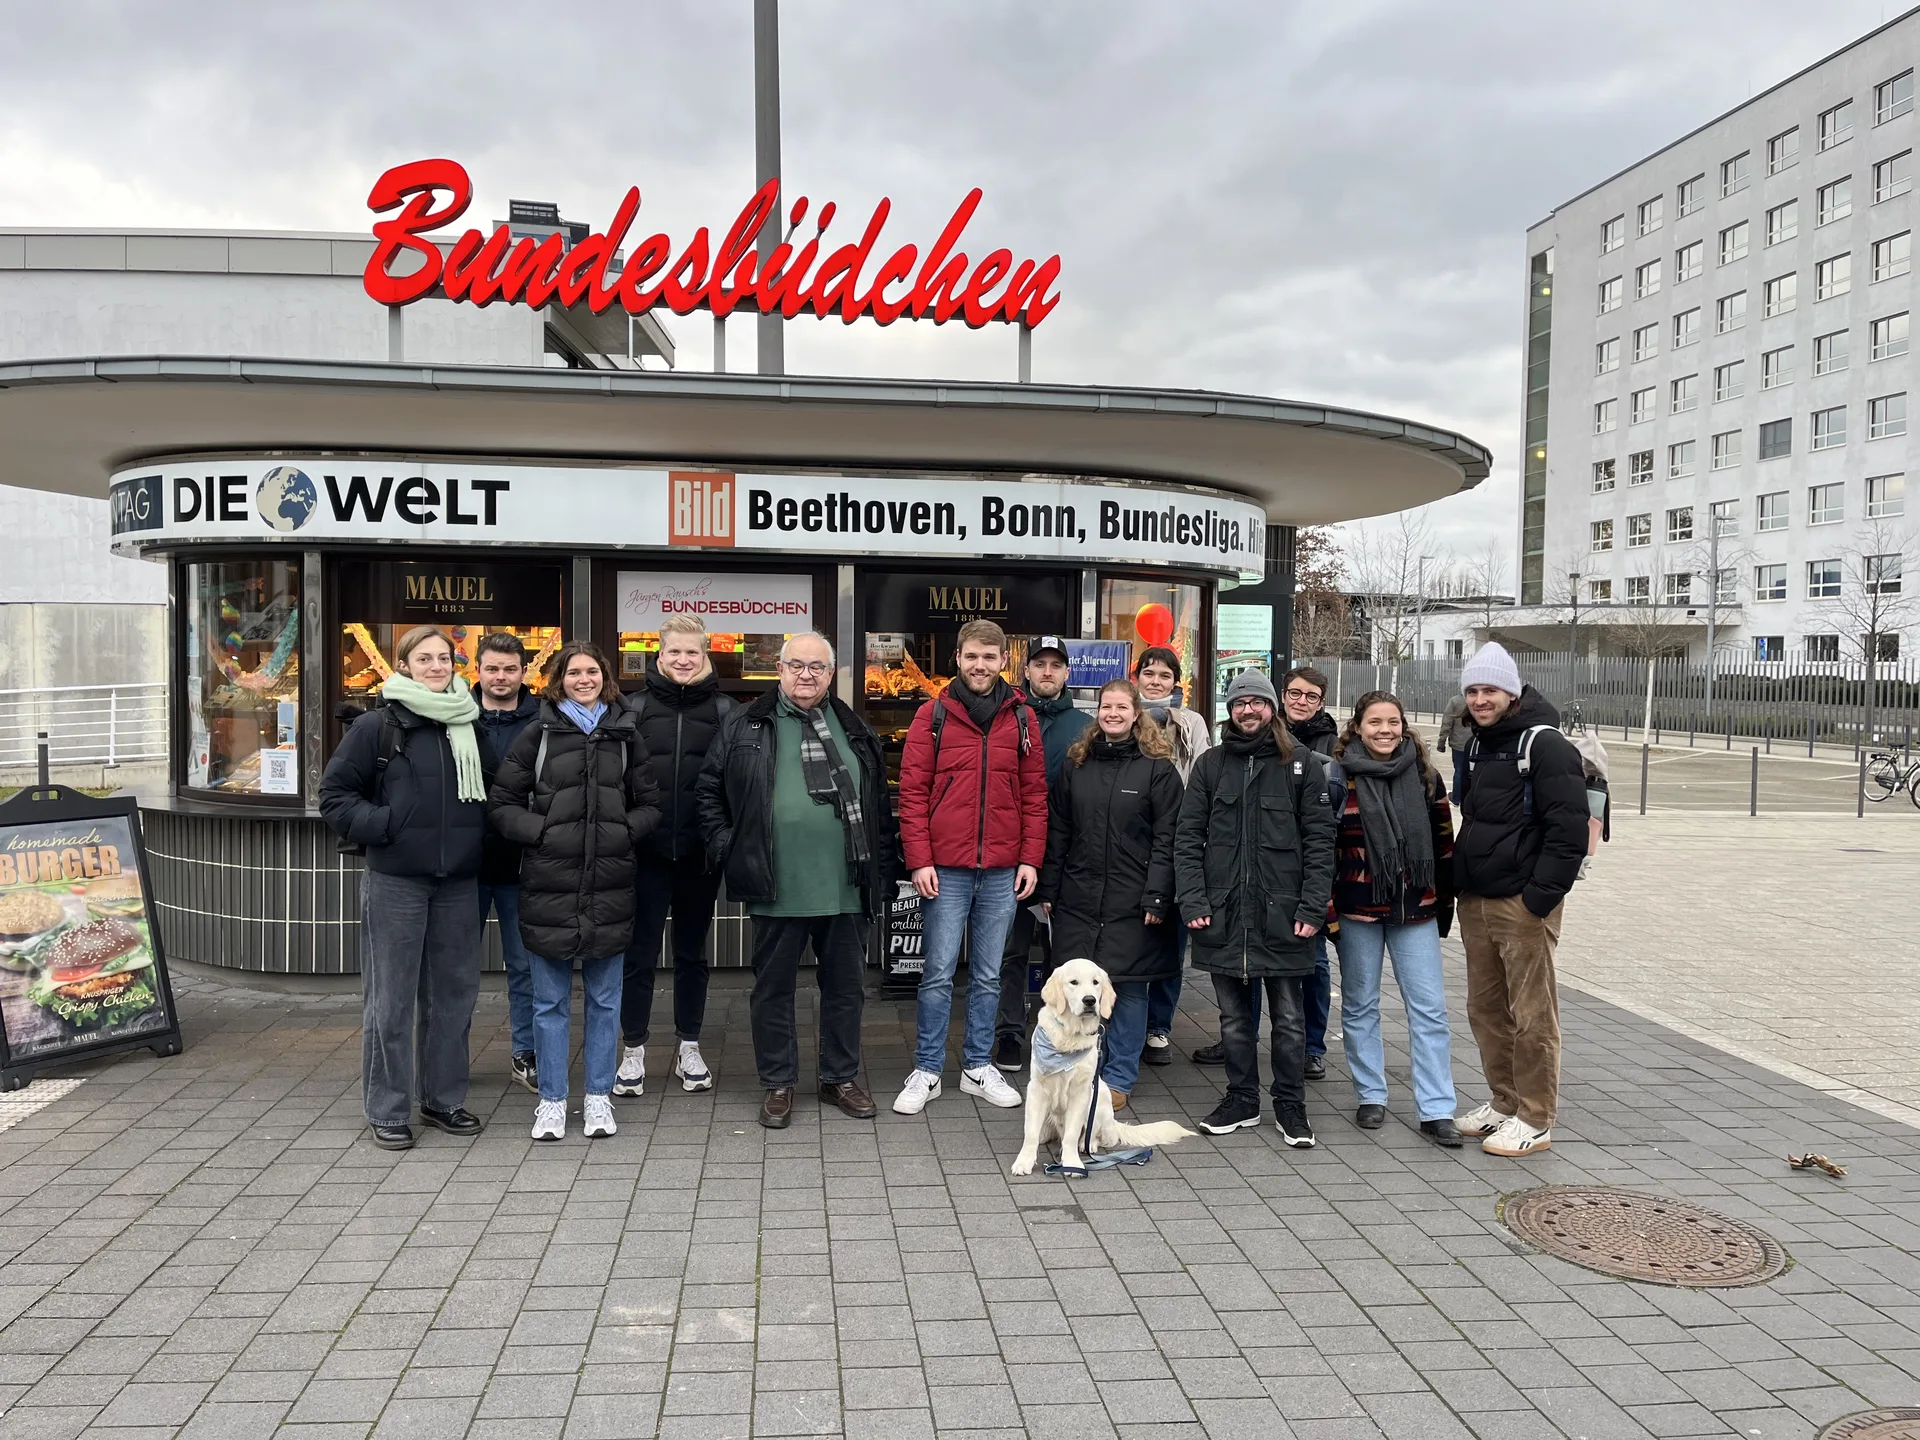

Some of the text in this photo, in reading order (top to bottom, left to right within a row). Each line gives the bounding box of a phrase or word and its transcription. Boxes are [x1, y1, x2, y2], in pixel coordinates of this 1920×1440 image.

[364, 158, 1060, 329] Bundesbüdchen
[174, 476, 248, 522] DIE
[674, 480, 730, 537] Bild
[749, 489, 967, 540] Beethoven,
[982, 496, 1086, 543] Bonn,
[1100, 500, 1244, 553] Bundesliga.
[405, 575, 493, 601] MAUEL
[929, 586, 1008, 611] MAUEL
[434, 605, 465, 613] 1883
[662, 599, 808, 614] BUNDESBÜDCHEN
[1081, 655, 1120, 666] Allgemeine
[7, 828, 103, 850] homemade
[0, 845, 122, 885] BURGER
[58, 992, 150, 1015] Crispy Chicken
[81, 986, 125, 999] KNUSPRIGER
